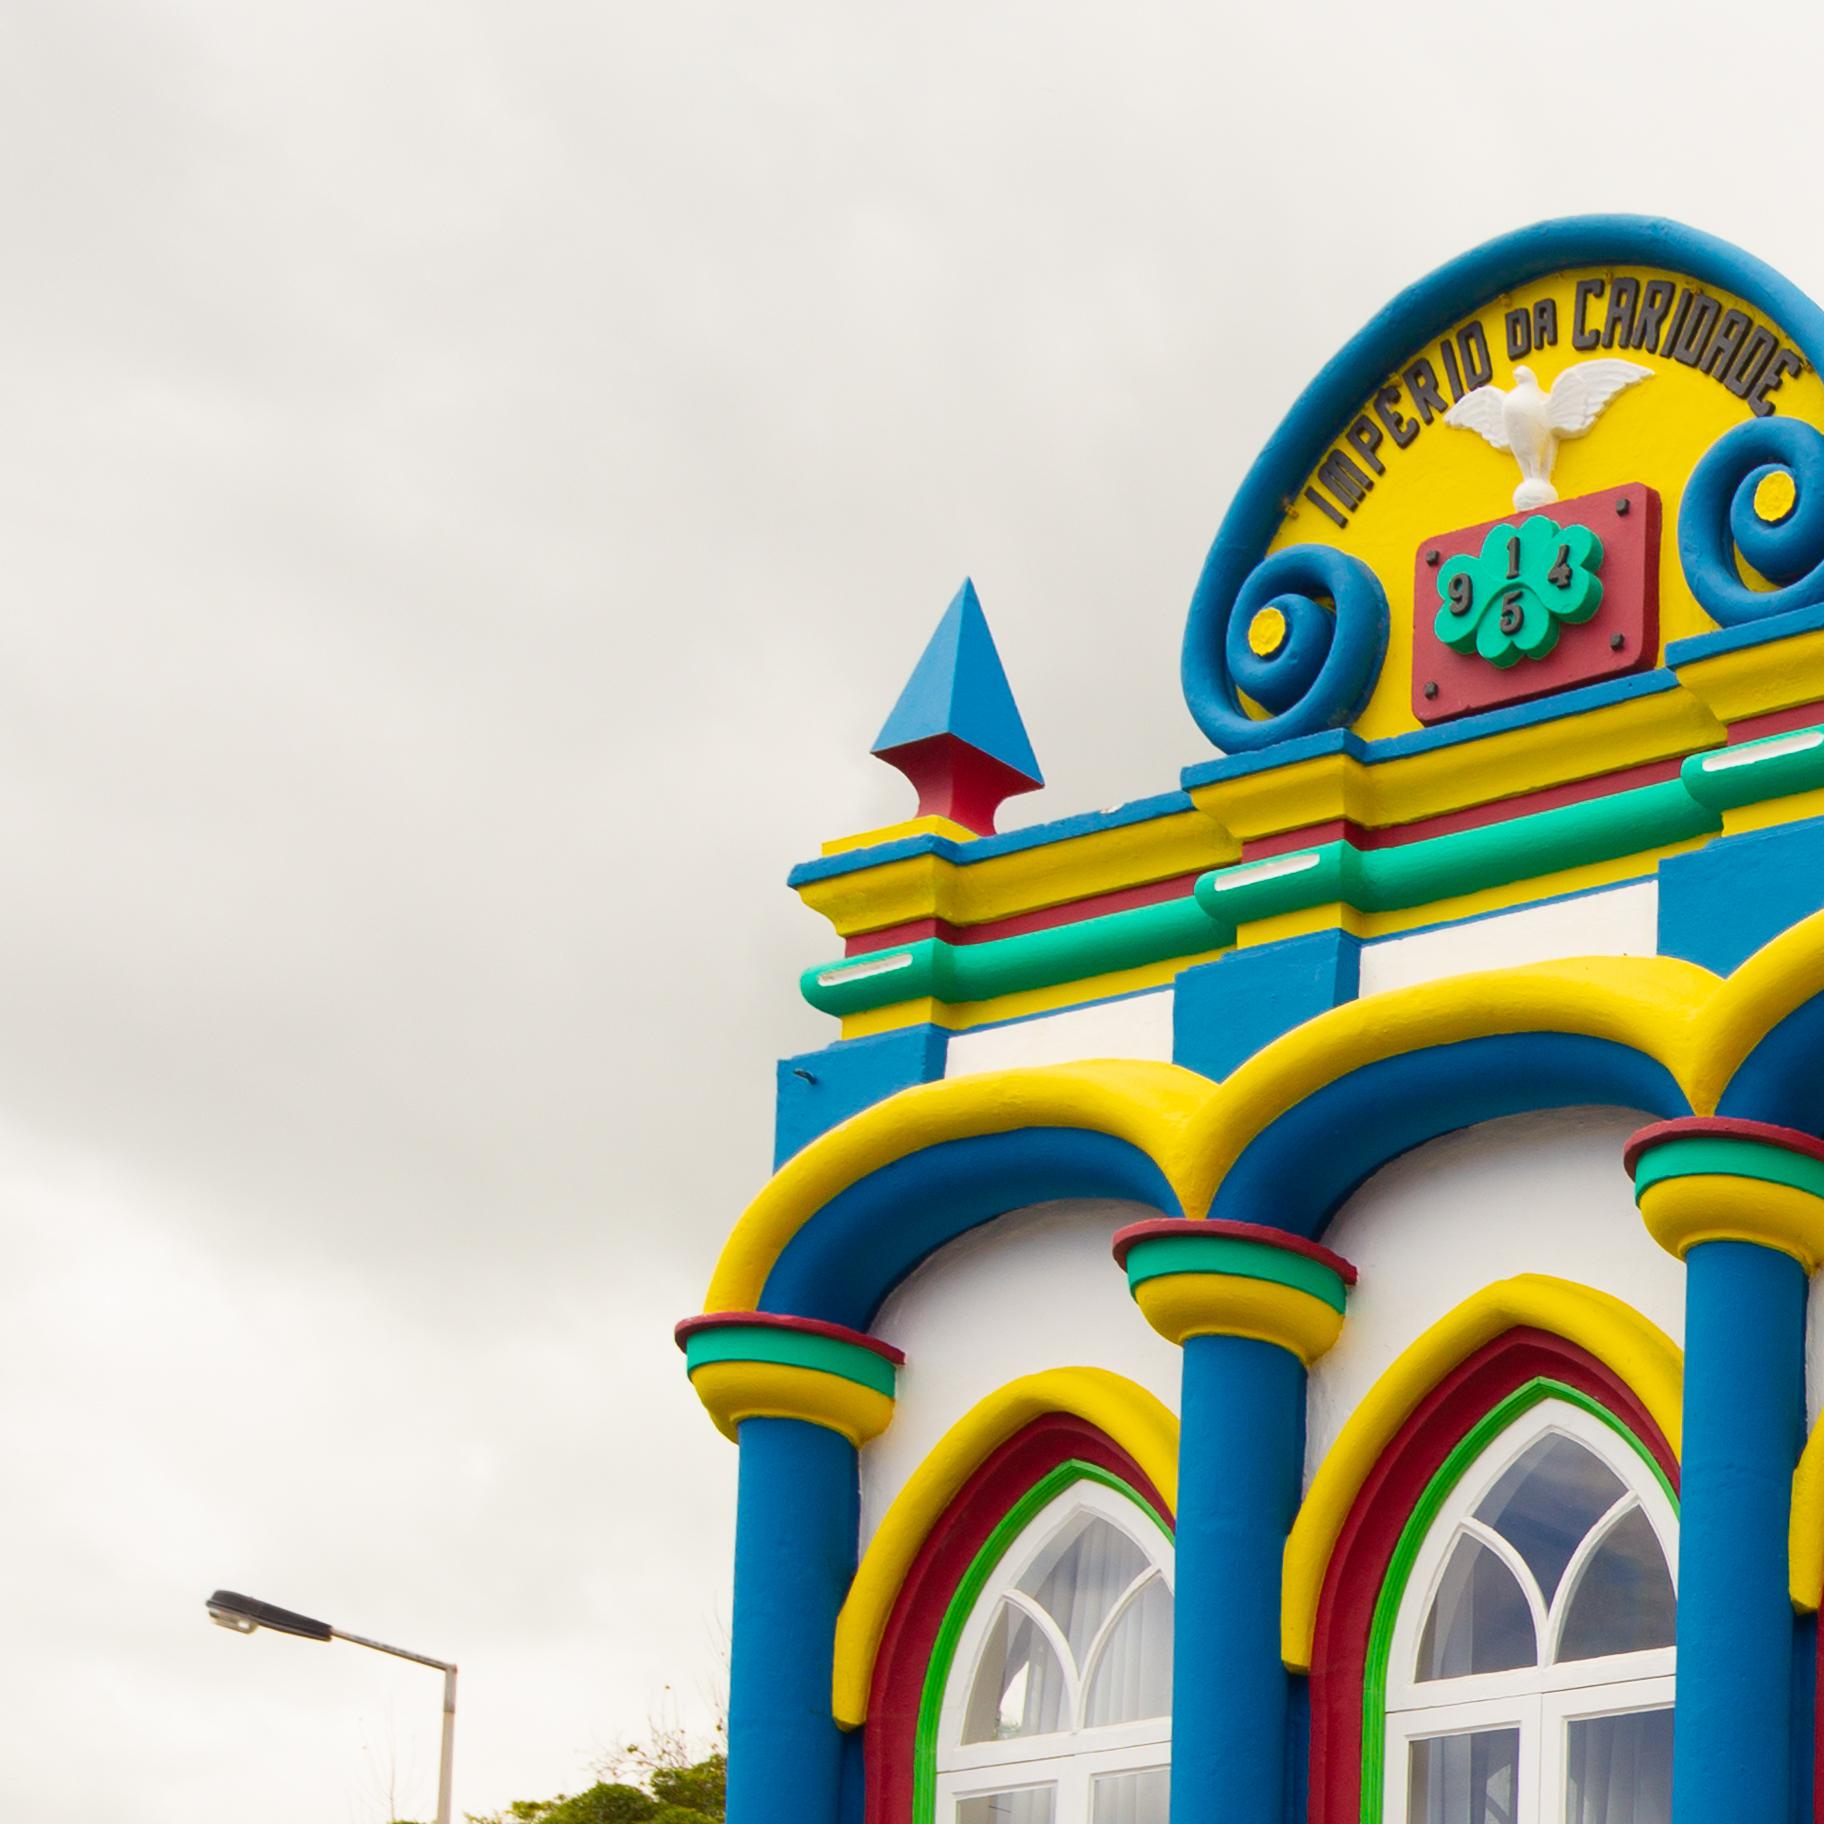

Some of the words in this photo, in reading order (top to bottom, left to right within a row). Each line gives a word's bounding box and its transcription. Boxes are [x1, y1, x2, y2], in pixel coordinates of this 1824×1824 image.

[1304, 320, 1494, 529] IMPERIO
[1504, 298, 1558, 362] DA
[1573, 277, 1804, 418] CARIDADE
